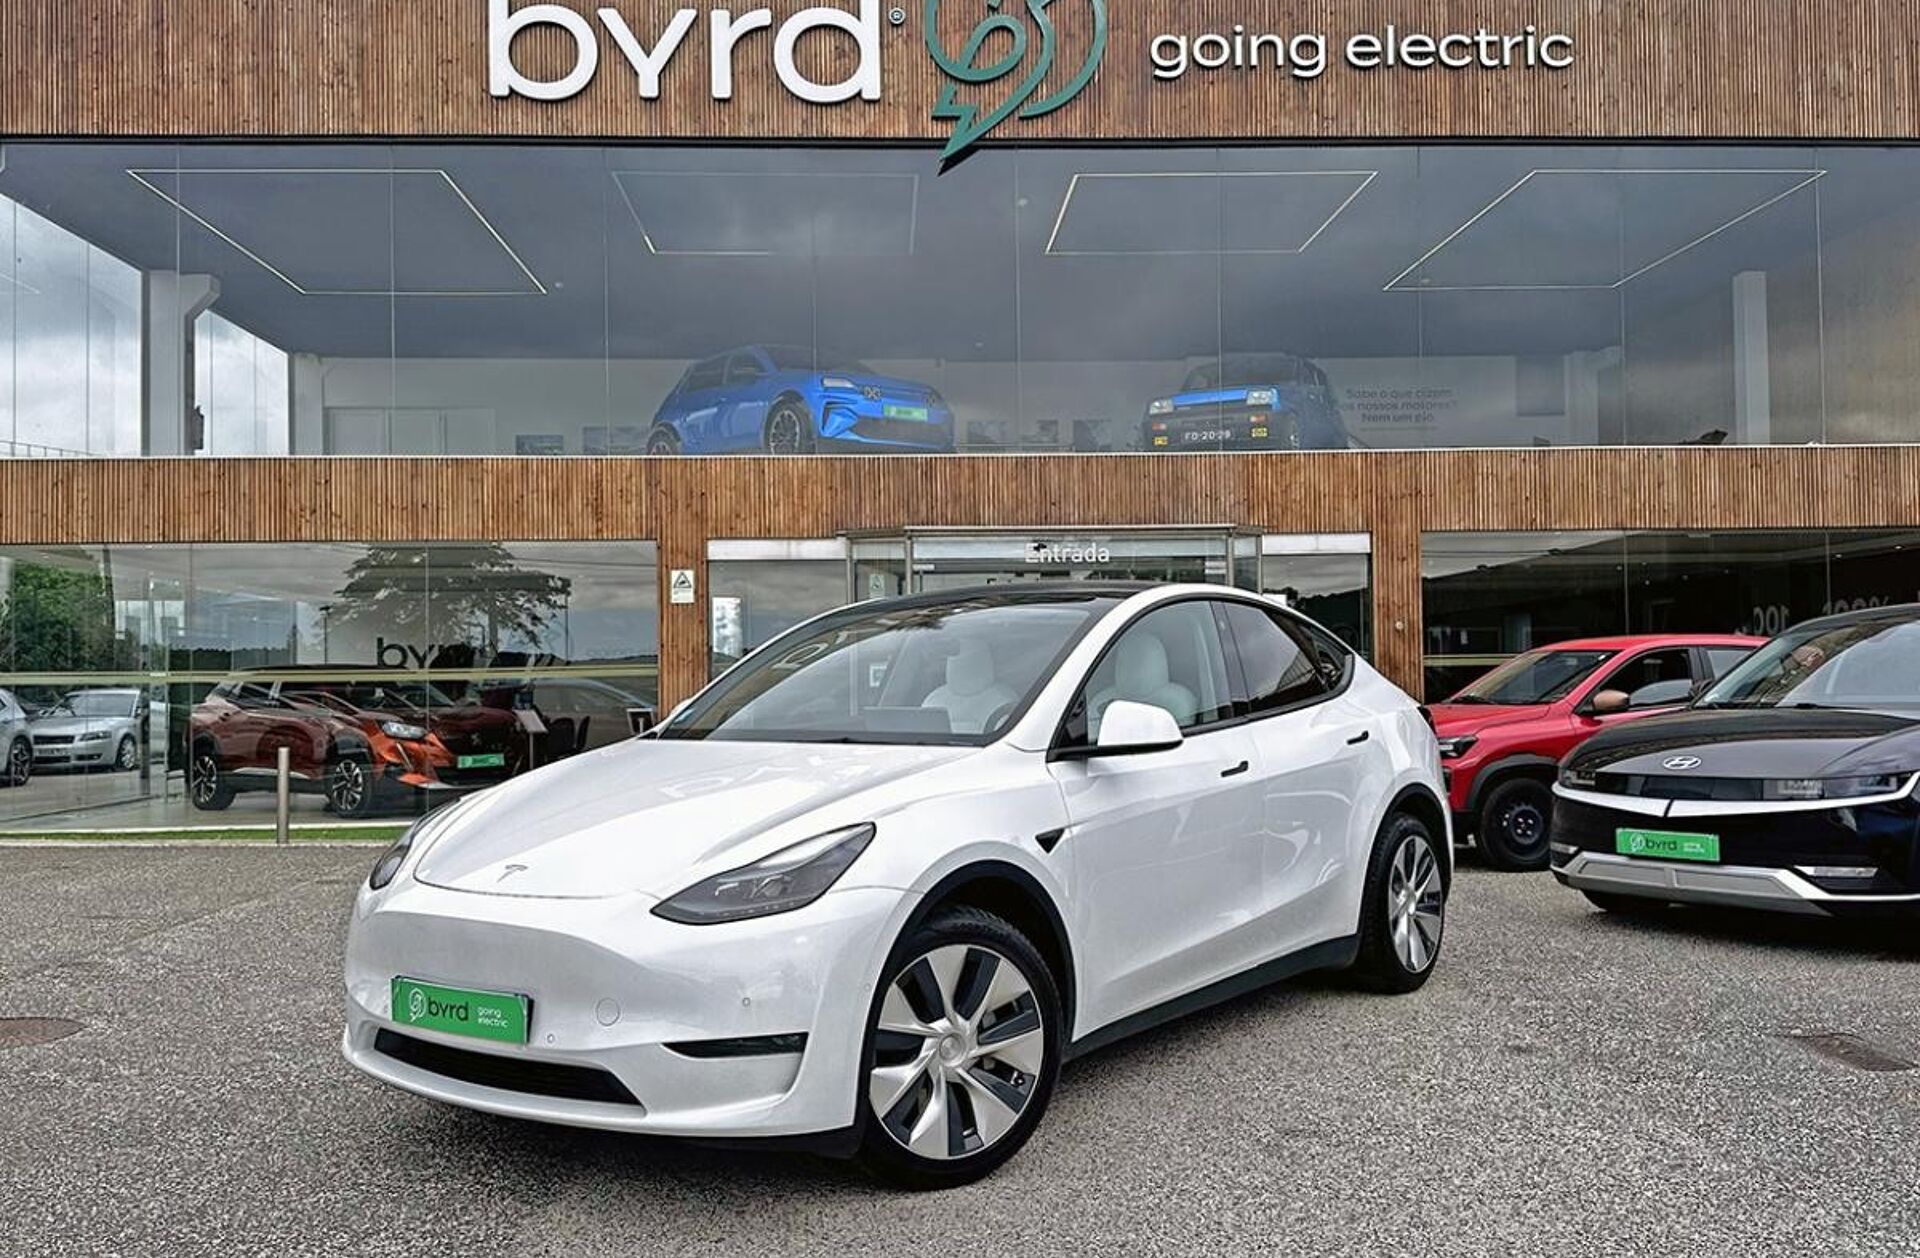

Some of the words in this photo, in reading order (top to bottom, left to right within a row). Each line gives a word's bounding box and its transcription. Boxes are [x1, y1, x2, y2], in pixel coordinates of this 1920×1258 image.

[488, 0, 881, 103] byrd
[1150, 25, 1327, 78] going
[1345, 24, 1575, 68] electric
[1024, 541, 1110, 564] Entrada
[428, 997, 469, 1022] byrd
